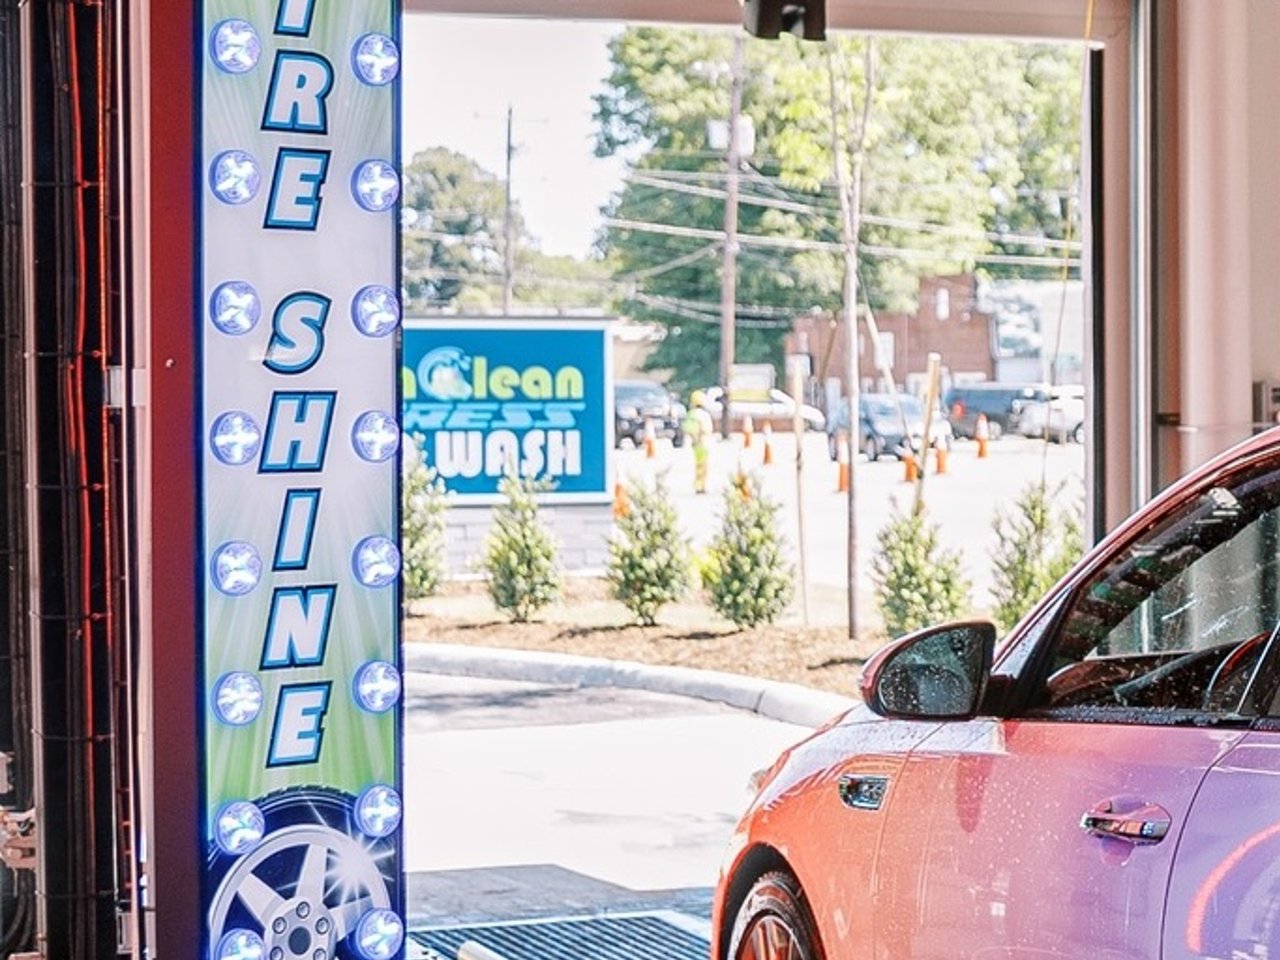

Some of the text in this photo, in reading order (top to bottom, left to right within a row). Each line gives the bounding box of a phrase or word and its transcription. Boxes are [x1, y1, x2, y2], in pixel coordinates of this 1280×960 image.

[402, 402, 586, 429] RESS
[434, 429, 582, 479] WASH
[256, 290, 338, 769] SHINE
